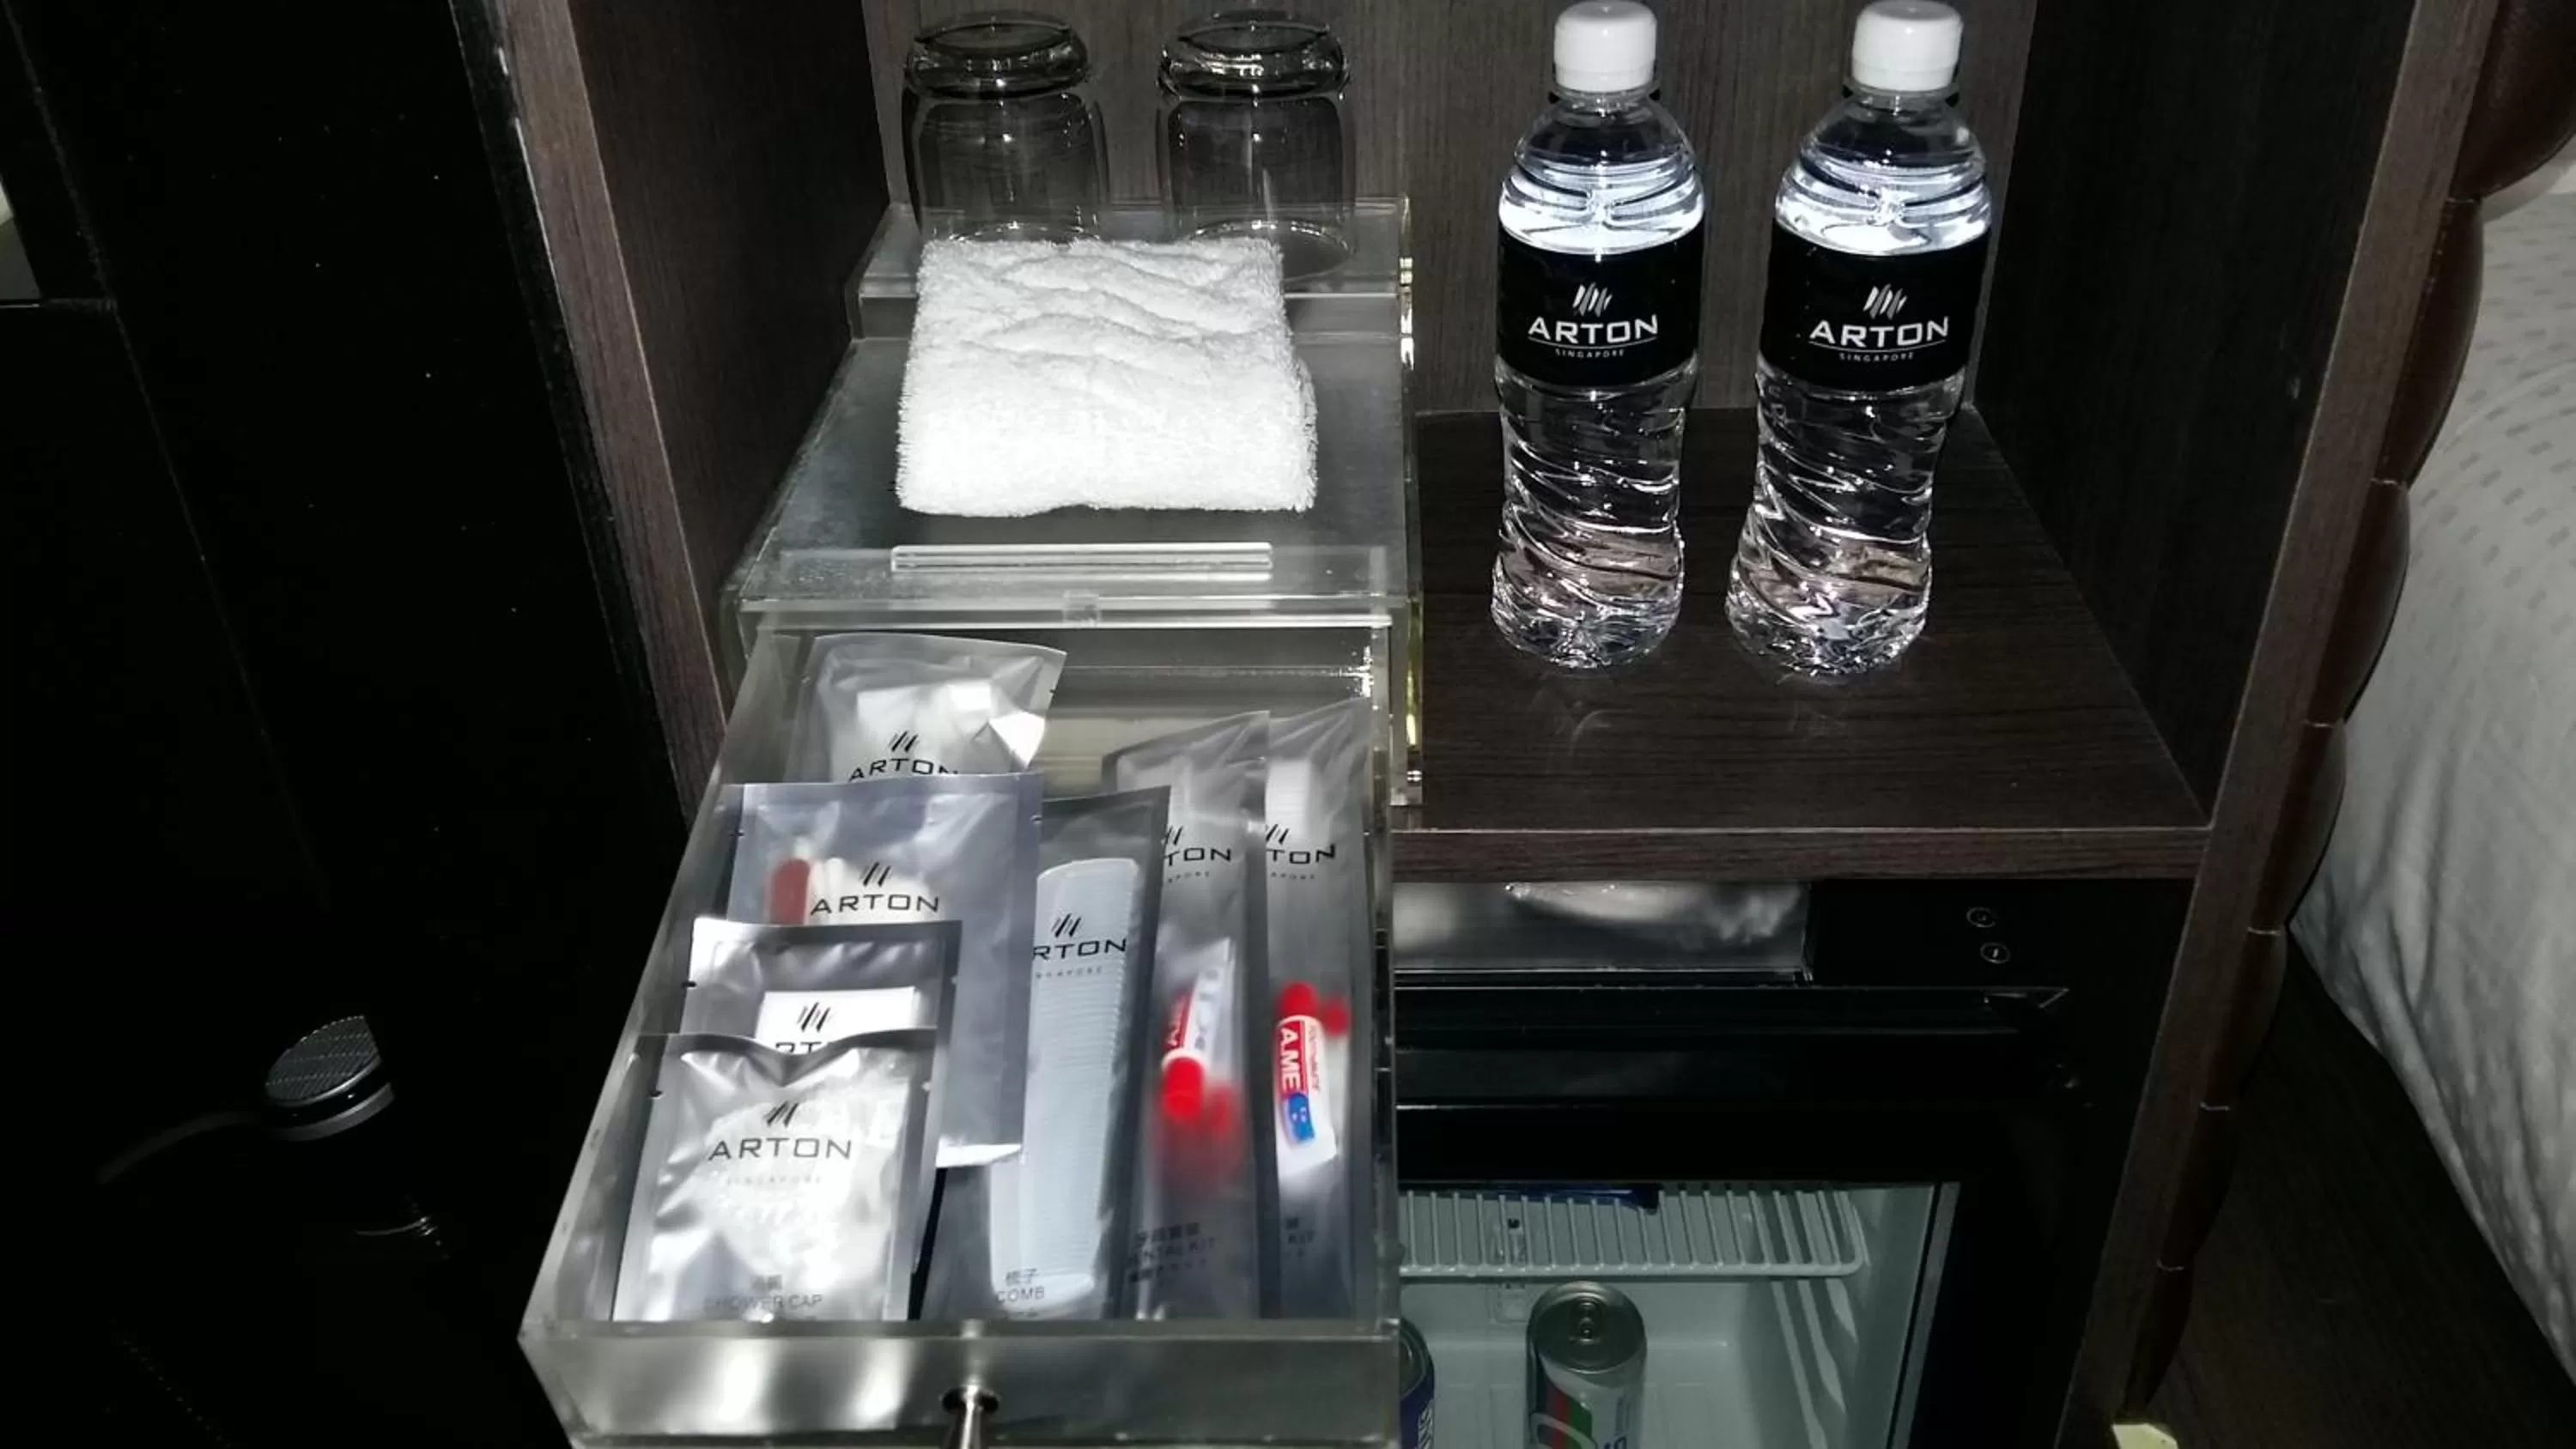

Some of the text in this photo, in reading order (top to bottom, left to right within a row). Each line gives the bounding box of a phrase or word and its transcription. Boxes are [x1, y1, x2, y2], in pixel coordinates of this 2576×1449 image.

[1528, 313, 1658, 344] ARTON
[1809, 316, 1948, 348] ARTON
[1555, 348, 1625, 359] SINGAPORE
[1839, 351, 1914, 362] SINGAPORE
[1166, 847, 1231, 867] TON
[1266, 843, 1336, 865] TON
[810, 894, 939, 916] ARTON
[1032, 937, 1127, 961] RTON
[708, 1137, 852, 1161] ARTON
